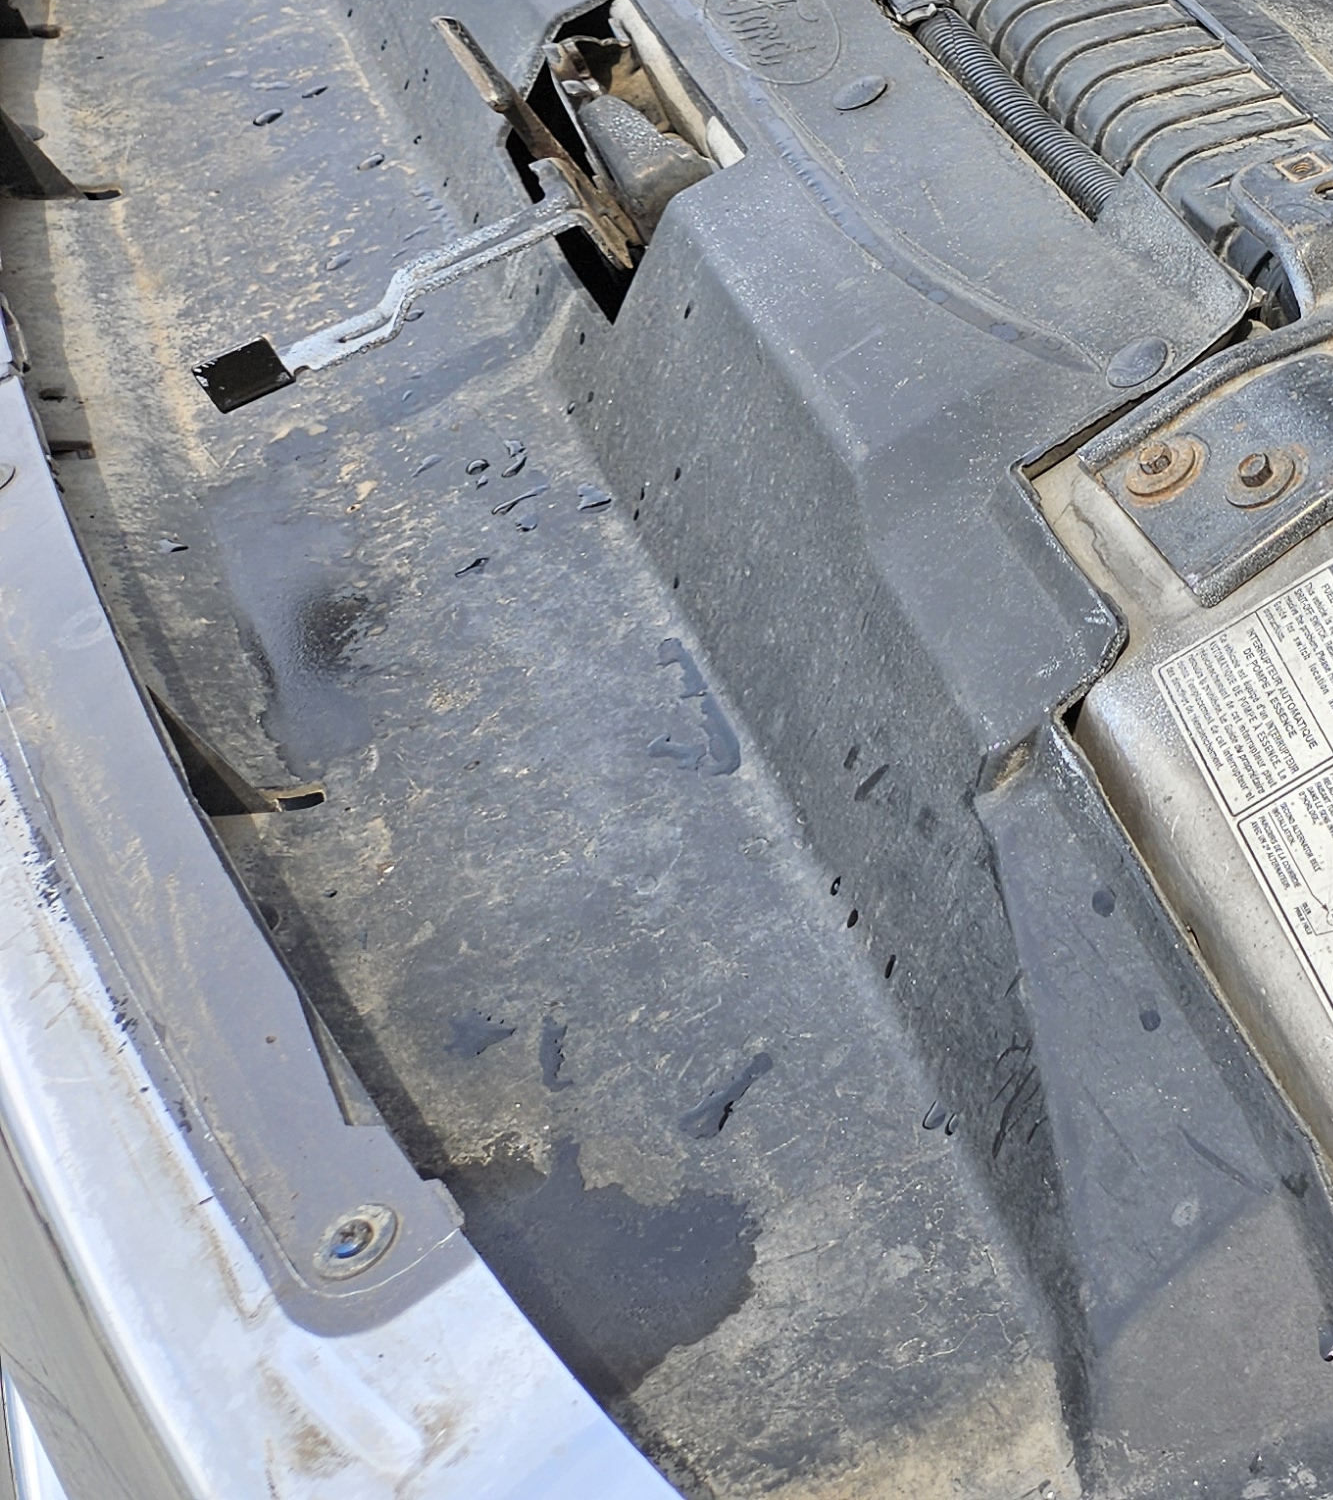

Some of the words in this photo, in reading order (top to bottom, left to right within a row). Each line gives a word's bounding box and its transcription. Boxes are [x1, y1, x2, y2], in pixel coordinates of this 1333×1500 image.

[1241, 646, 1255, 661] DE
[1248, 658, 1271, 690] POMPE
[1268, 695, 1298, 739] ESSENCE
